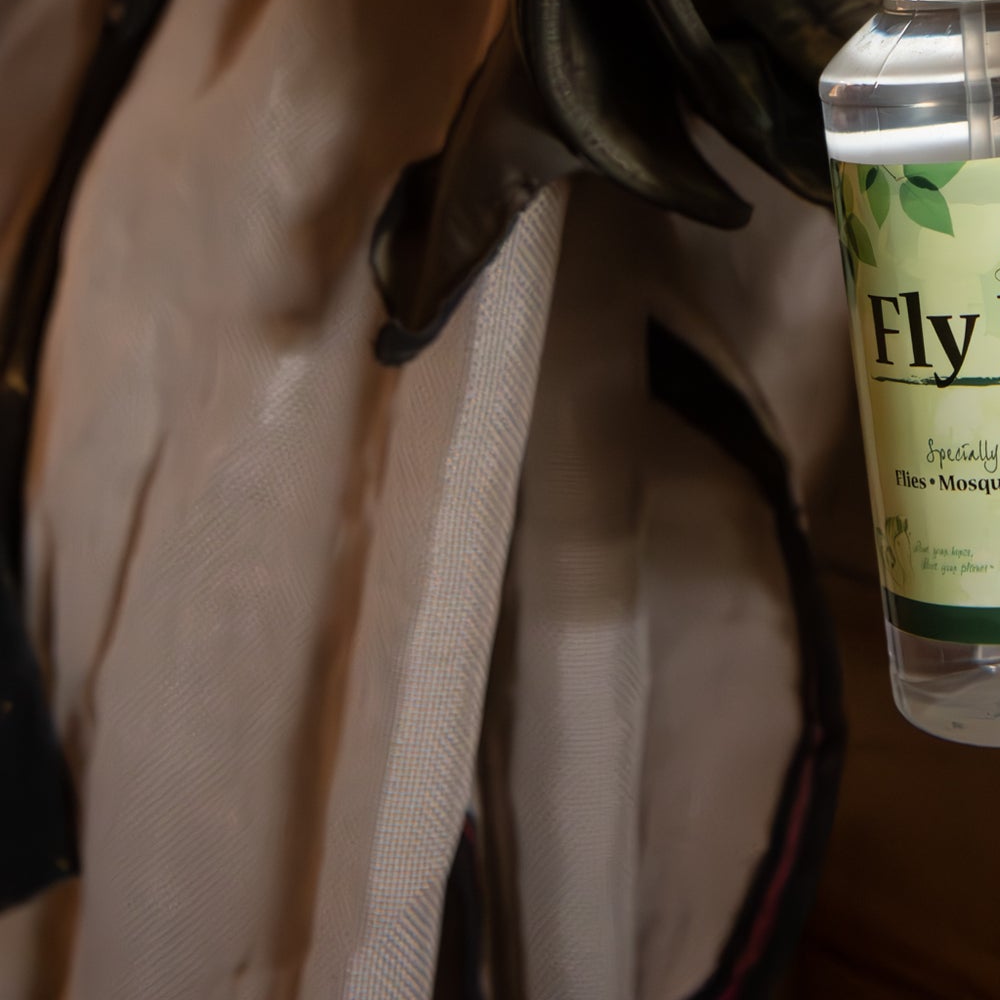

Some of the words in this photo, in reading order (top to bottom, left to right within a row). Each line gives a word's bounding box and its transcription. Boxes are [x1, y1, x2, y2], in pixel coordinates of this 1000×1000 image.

[867, 291, 980, 388] Fly
[926, 438, 998, 473] Specially
[895, 469, 927, 489] Flies
